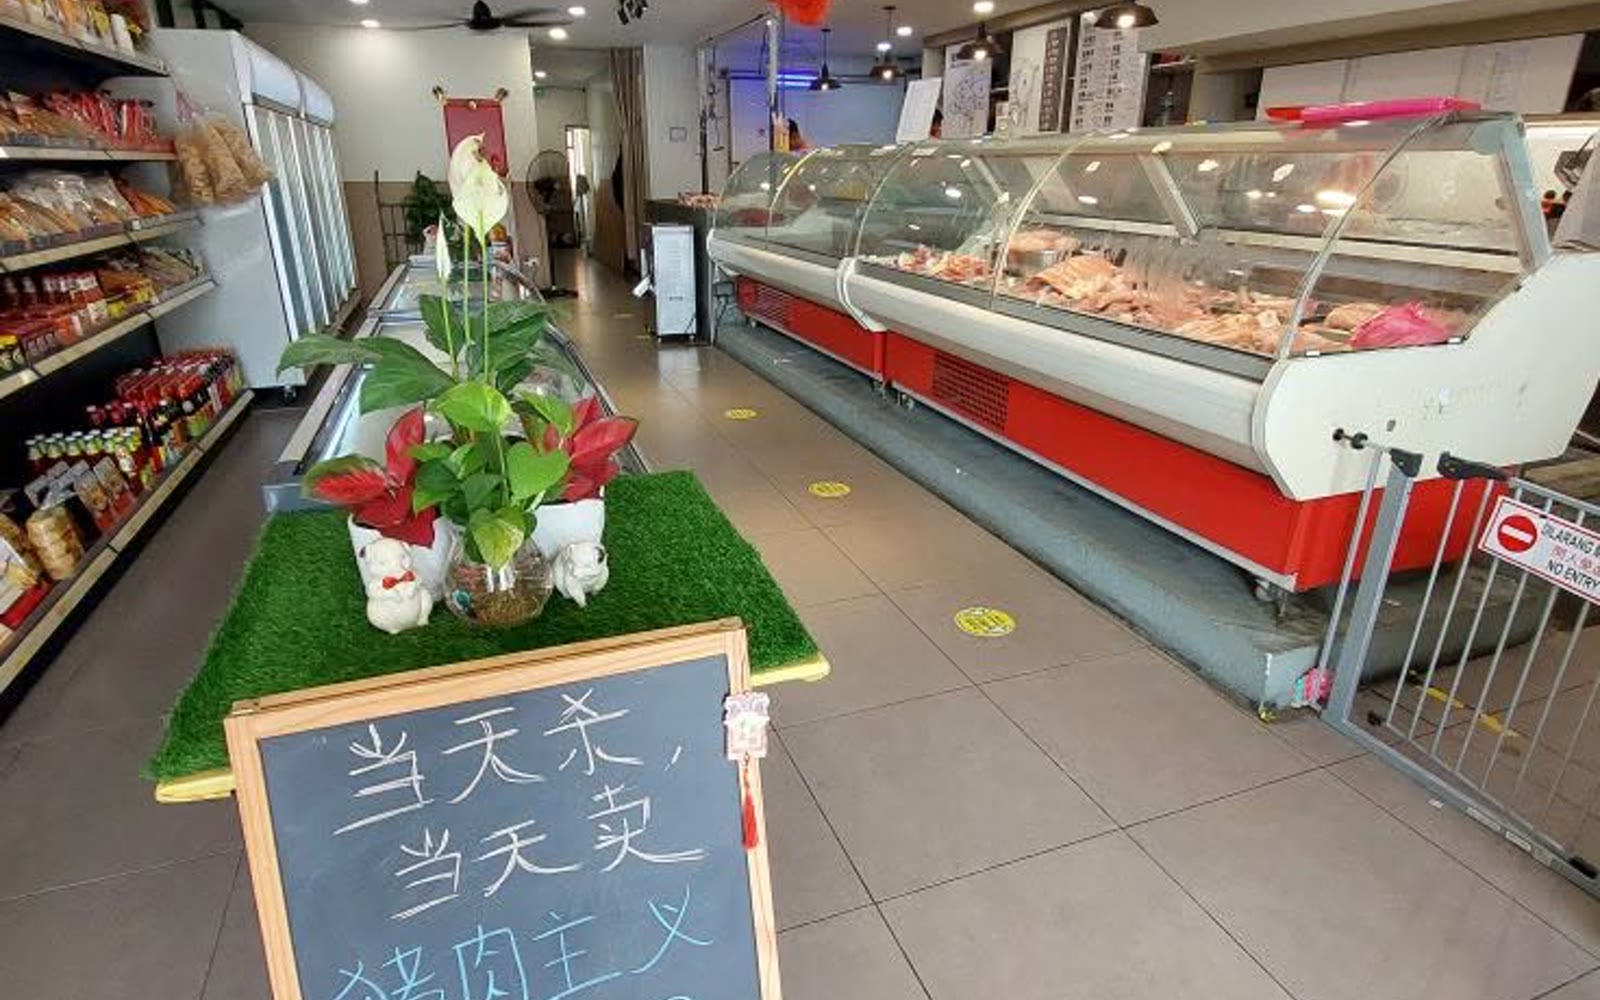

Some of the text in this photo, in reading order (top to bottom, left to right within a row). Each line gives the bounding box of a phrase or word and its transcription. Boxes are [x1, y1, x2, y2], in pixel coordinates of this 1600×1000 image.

[1547, 559, 1564, 575] NO
[1564, 567, 1600, 589] ENTRY
[390, 784, 708, 919] 当天卖
